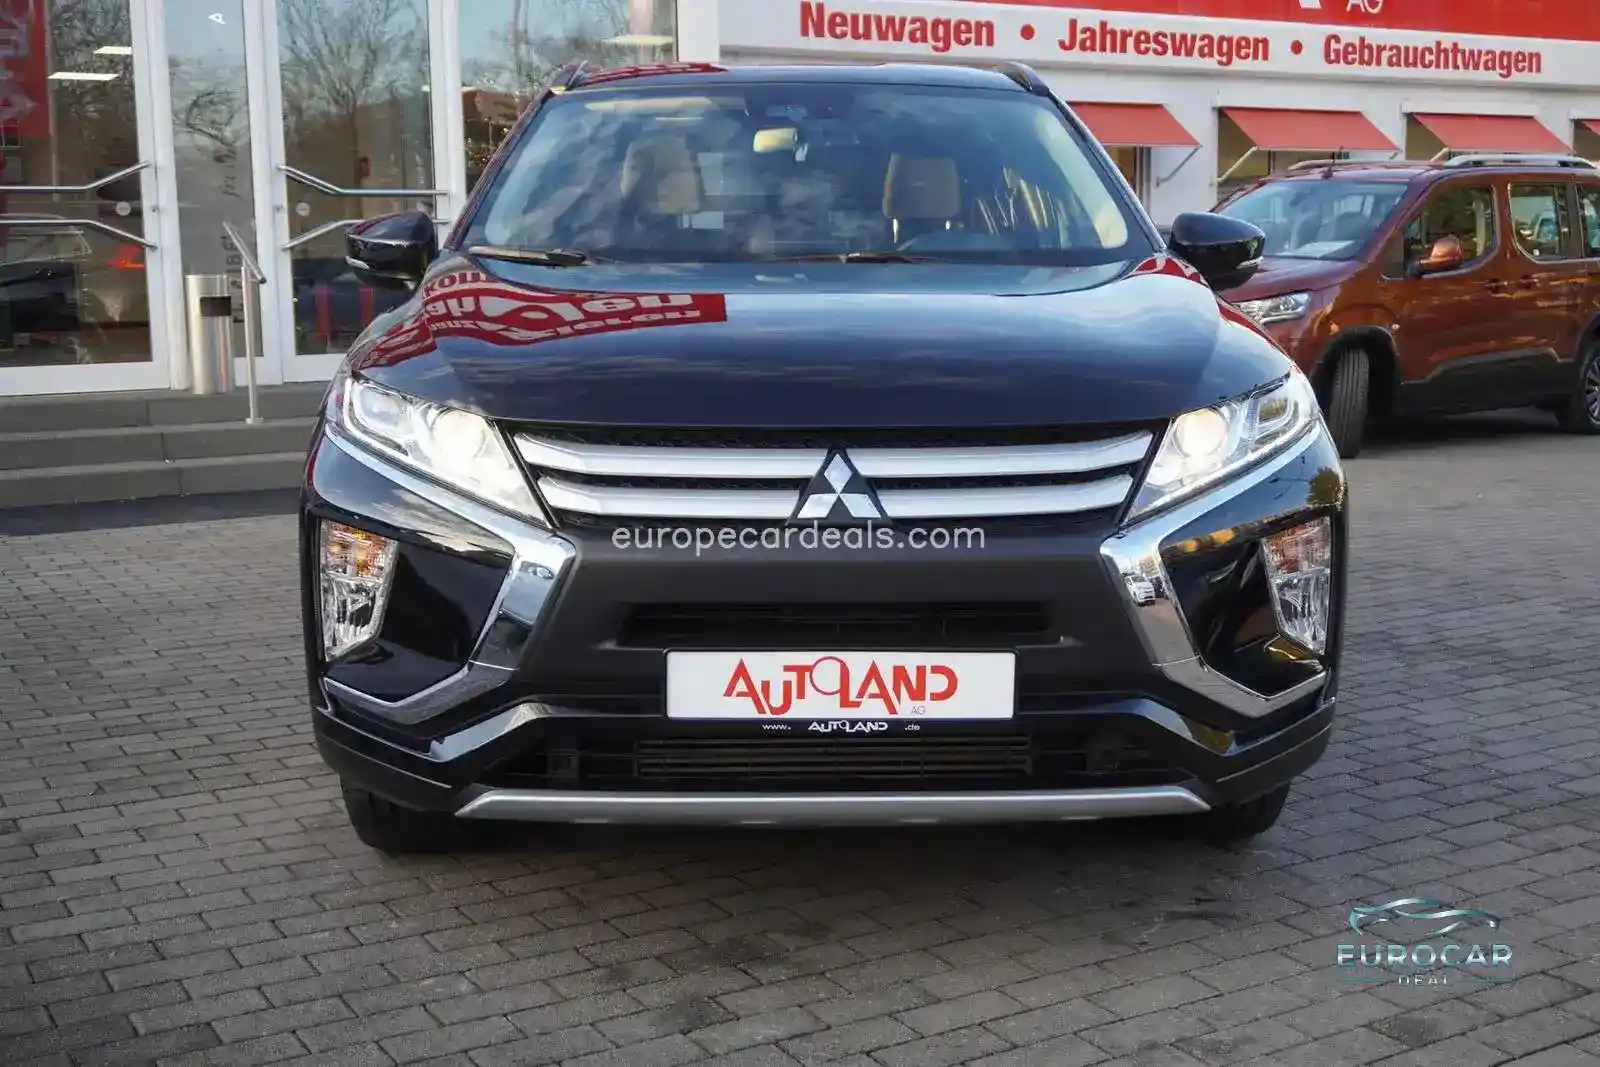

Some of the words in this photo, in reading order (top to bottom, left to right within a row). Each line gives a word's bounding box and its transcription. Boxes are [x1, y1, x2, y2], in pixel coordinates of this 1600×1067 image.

[799, 1, 995, 53] Neuwagen
[1058, 18, 1270, 66] Jahreswagen
[1323, 34, 1542, 79] Gebrauchtwagen
